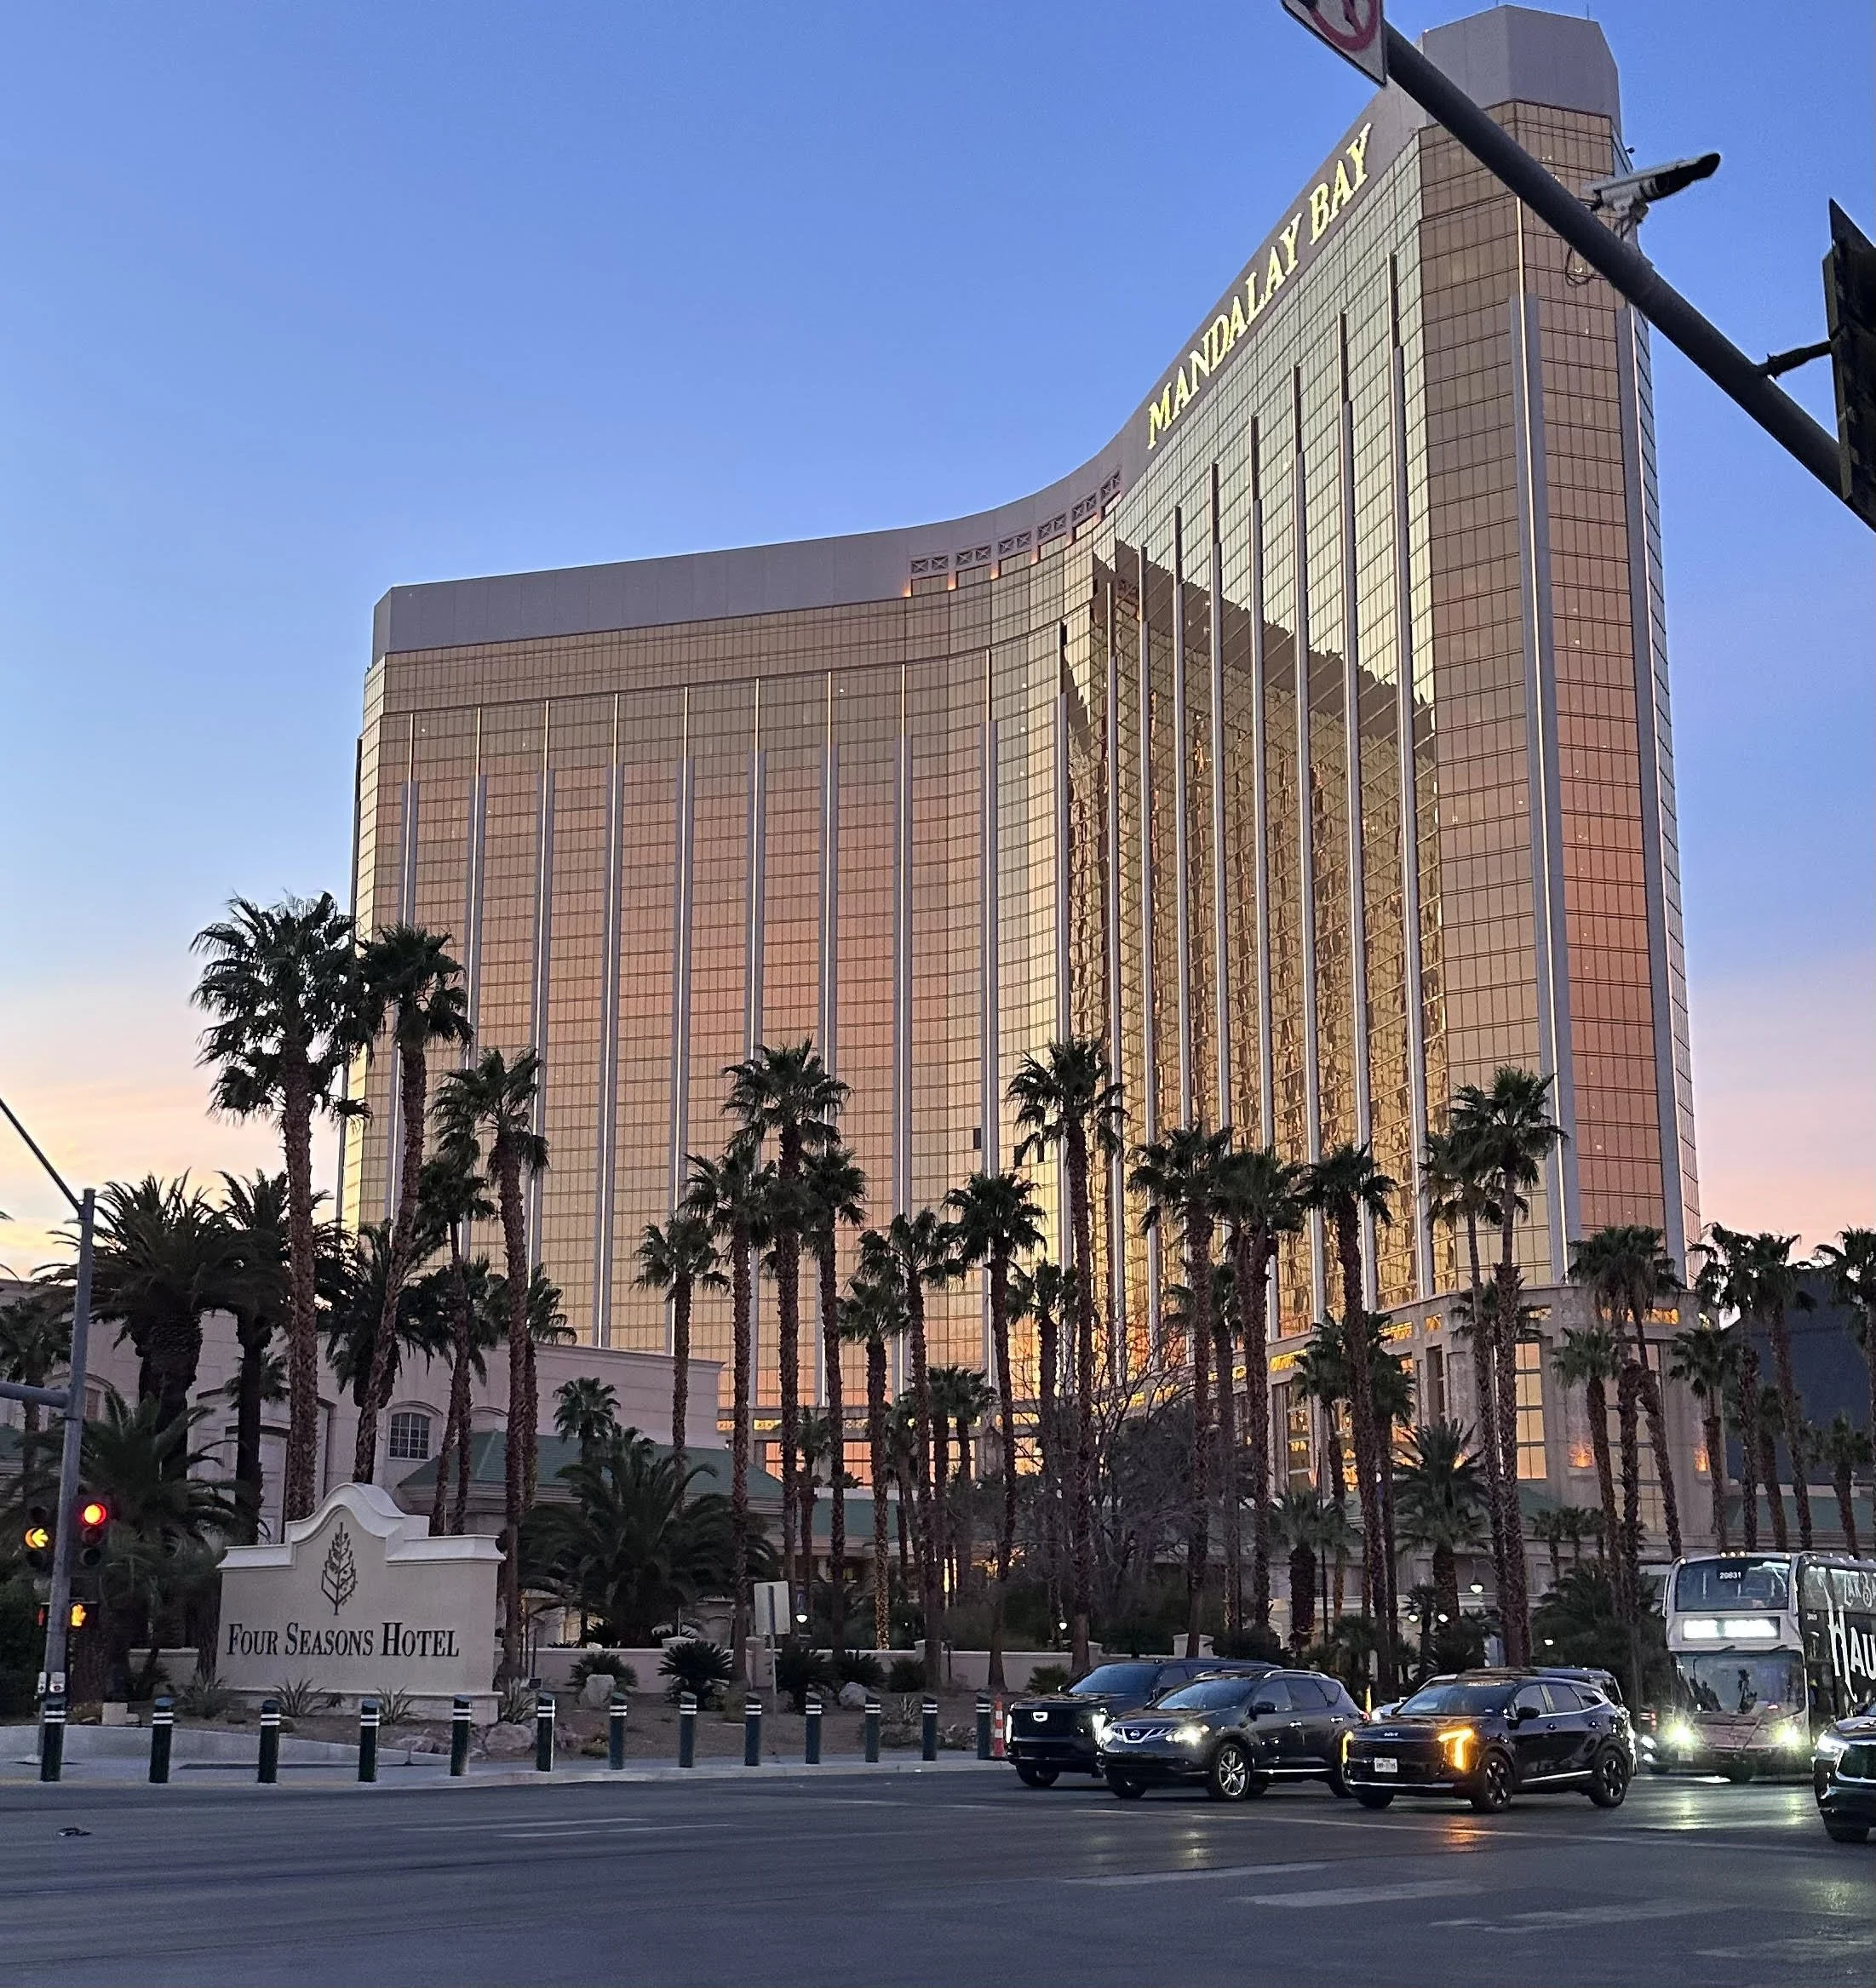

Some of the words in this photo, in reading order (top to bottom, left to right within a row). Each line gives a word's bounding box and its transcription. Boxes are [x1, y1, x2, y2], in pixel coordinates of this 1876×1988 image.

[1148, 213, 1302, 450] MANDALAY
[1309, 123, 1374, 245] BAY
[226, 1623, 278, 1656] FOUR
[285, 1621, 374, 1657] SEASONS
[381, 1622, 460, 1658] HOTEL
